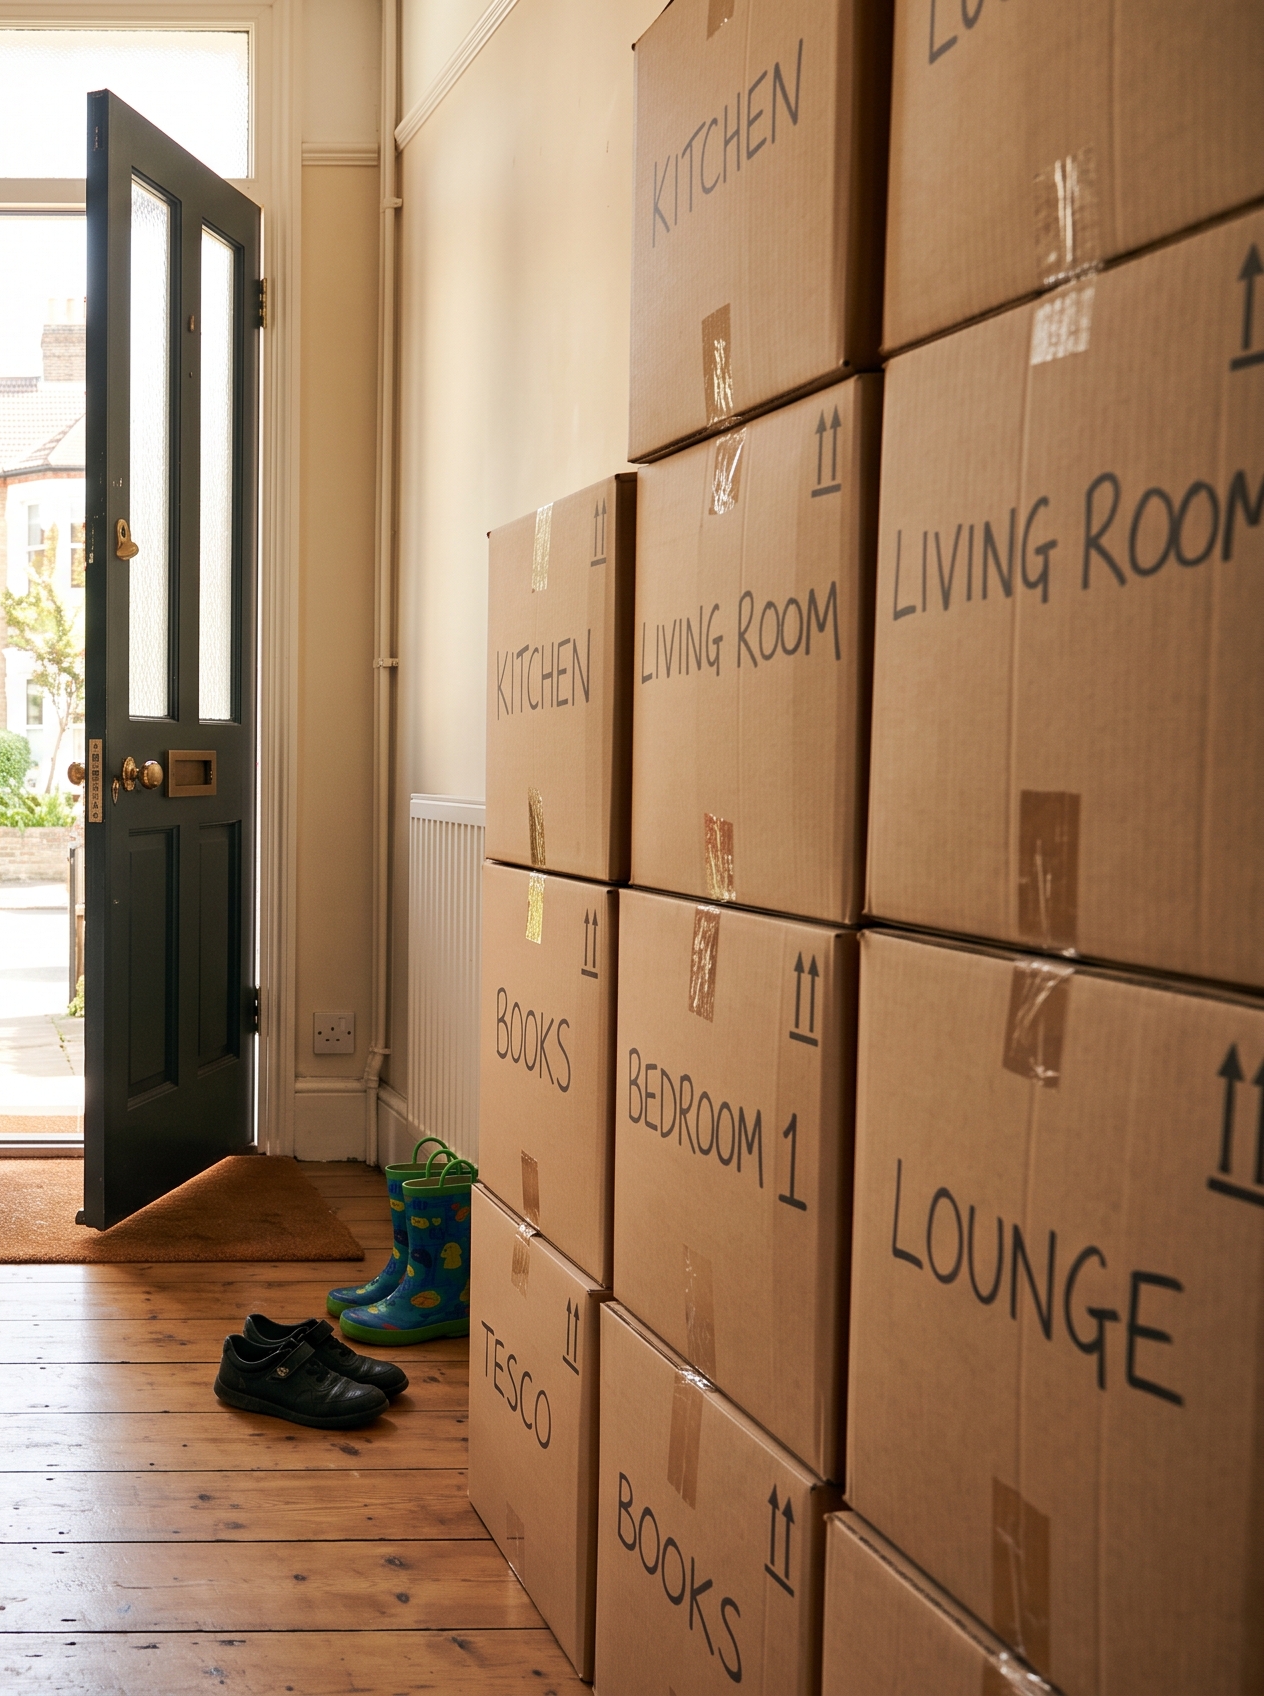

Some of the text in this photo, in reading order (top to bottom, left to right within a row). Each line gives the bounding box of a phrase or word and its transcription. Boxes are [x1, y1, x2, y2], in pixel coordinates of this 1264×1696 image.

[650, 37, 804, 248] KITCHEN
[892, 469, 1264, 621] LIVING ROOM
[495, 628, 592, 721] KITCHEN
[640, 581, 841, 685] LIVING ROOM
[495, 986, 572, 1094] BOOKS
[629, 1047, 808, 1212] BEDROOM 1
[891, 1157, 1186, 1408] LOUNGE
[480, 1320, 553, 1450] TESCO
[616, 1471, 744, 1685] BOOKS
